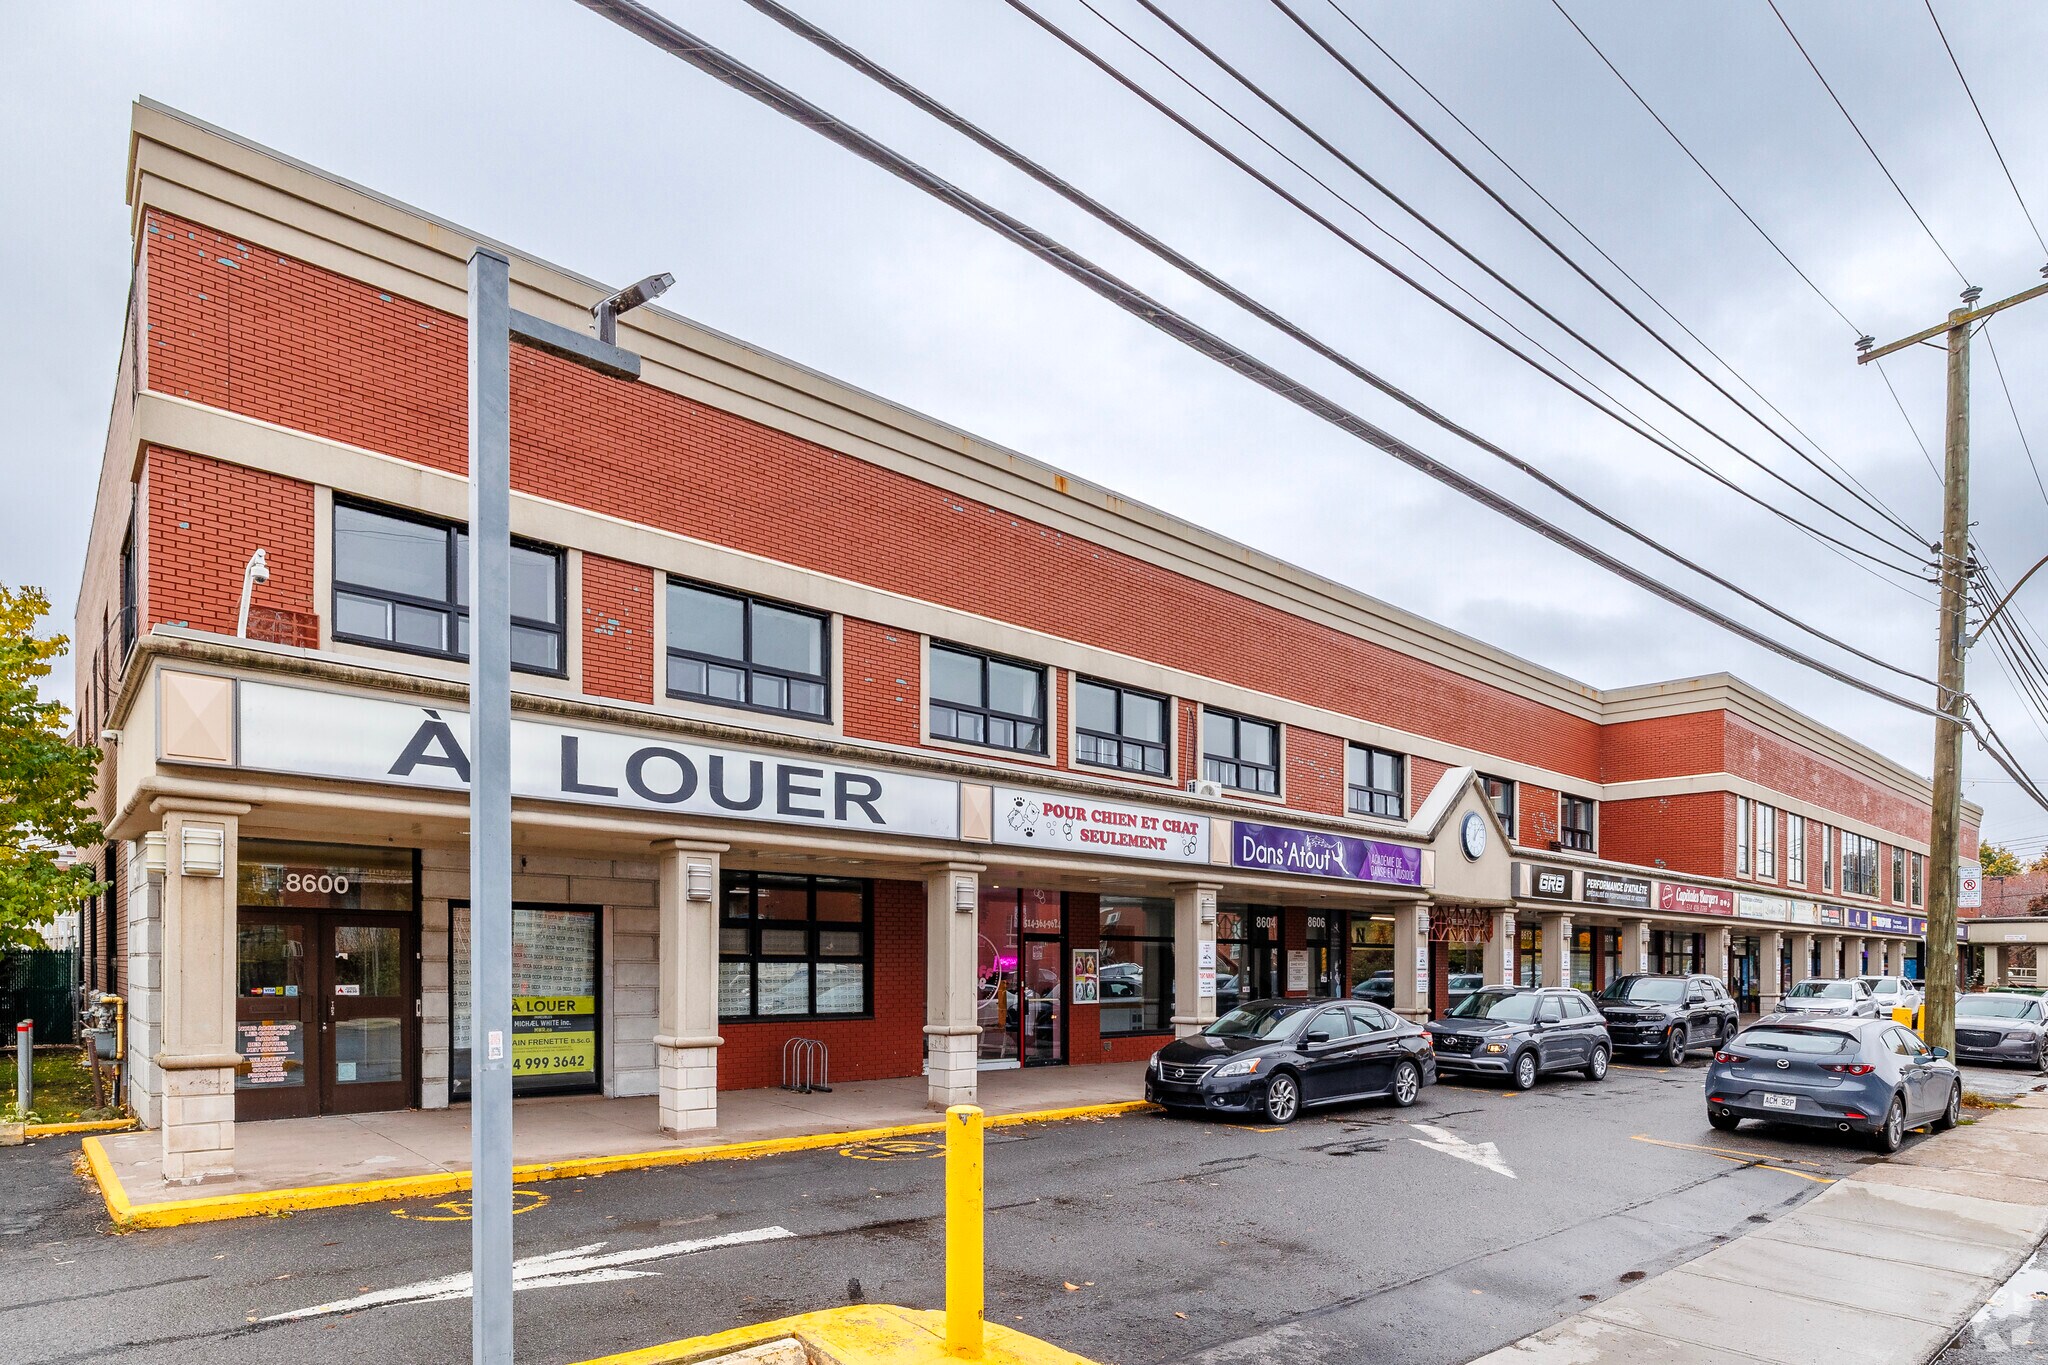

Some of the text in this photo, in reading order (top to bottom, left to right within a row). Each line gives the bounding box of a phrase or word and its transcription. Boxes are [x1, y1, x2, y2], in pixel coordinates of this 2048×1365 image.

[388, 708, 887, 824] À LOUER
[1042, 802, 1199, 836] POUR CHIEN ET CHAT
[1080, 828, 1167, 850] SEULEMENT
[1243, 836, 1330, 870] Dans'Atout
[1371, 853, 1403, 868] ACADÉMIE DE
[1371, 866, 1415, 882] DANSE ET MUSIQUE
[286, 874, 348, 894] 8600
[1586, 878, 1648, 895] PERFORMANCE D'ATHLÈTE
[1700, 890, 1718, 908] Burgers
[1256, 916, 1276, 929] 8604
[1308, 916, 1325, 928] 8606
[512, 999, 576, 1012] À LOUER
[528, 1038, 568, 1046] FRENETTE
[525, 1058, 549, 1069] 999
[554, 1056, 584, 1068] 3642
[1765, 1096, 1794, 1106] ACM 92P
